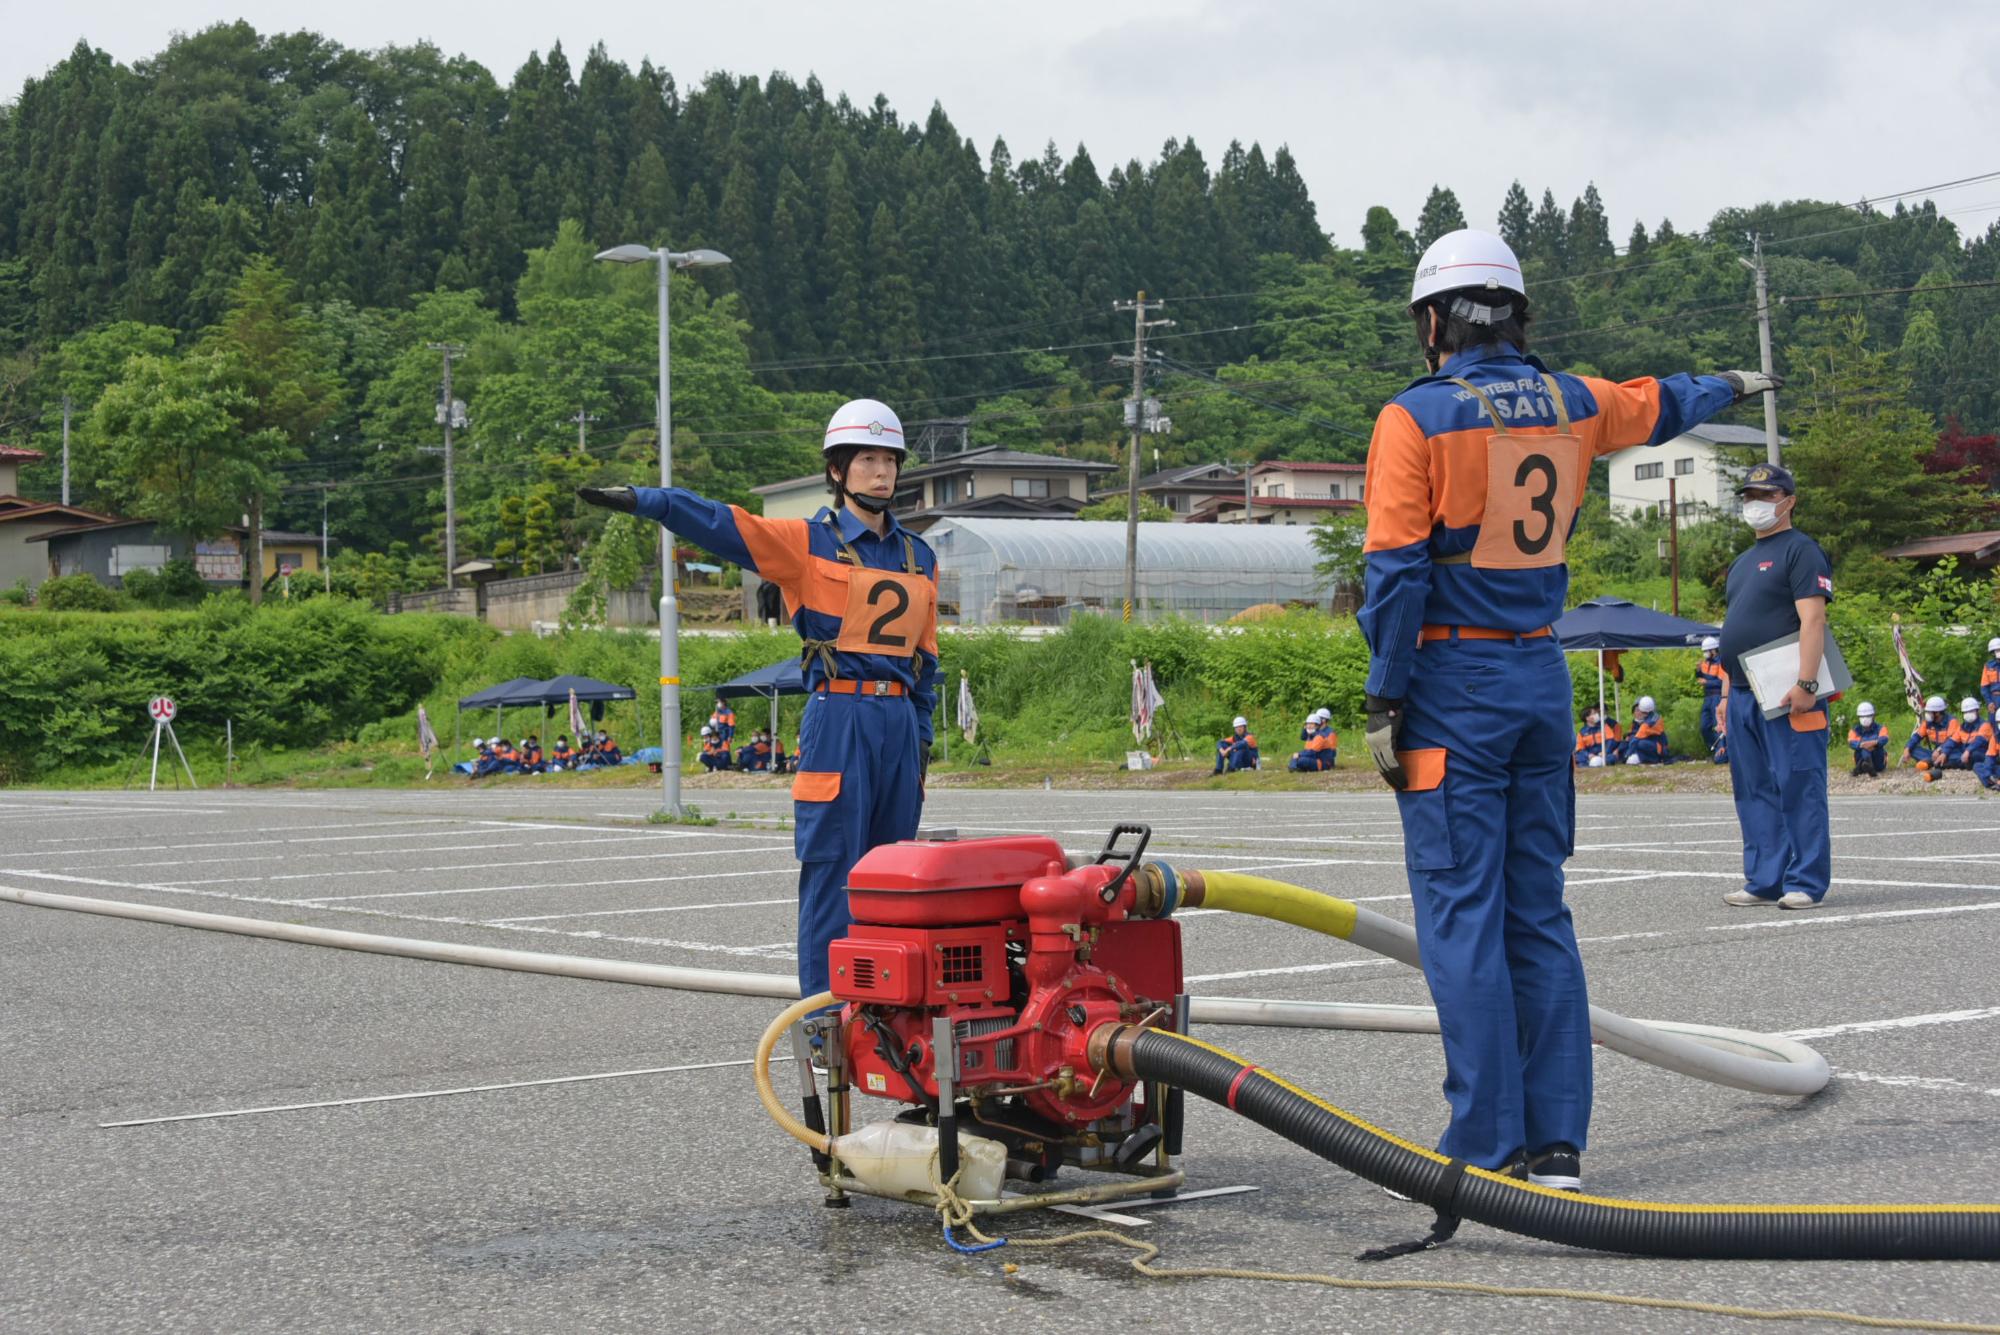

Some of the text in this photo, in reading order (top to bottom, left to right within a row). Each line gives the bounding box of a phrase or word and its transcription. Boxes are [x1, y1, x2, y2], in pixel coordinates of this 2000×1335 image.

[1452, 381, 1517, 402] VONTEER
[1513, 454, 1557, 555] 3
[867, 580, 909, 647] 2
[152, 698, 173, 718] 火
